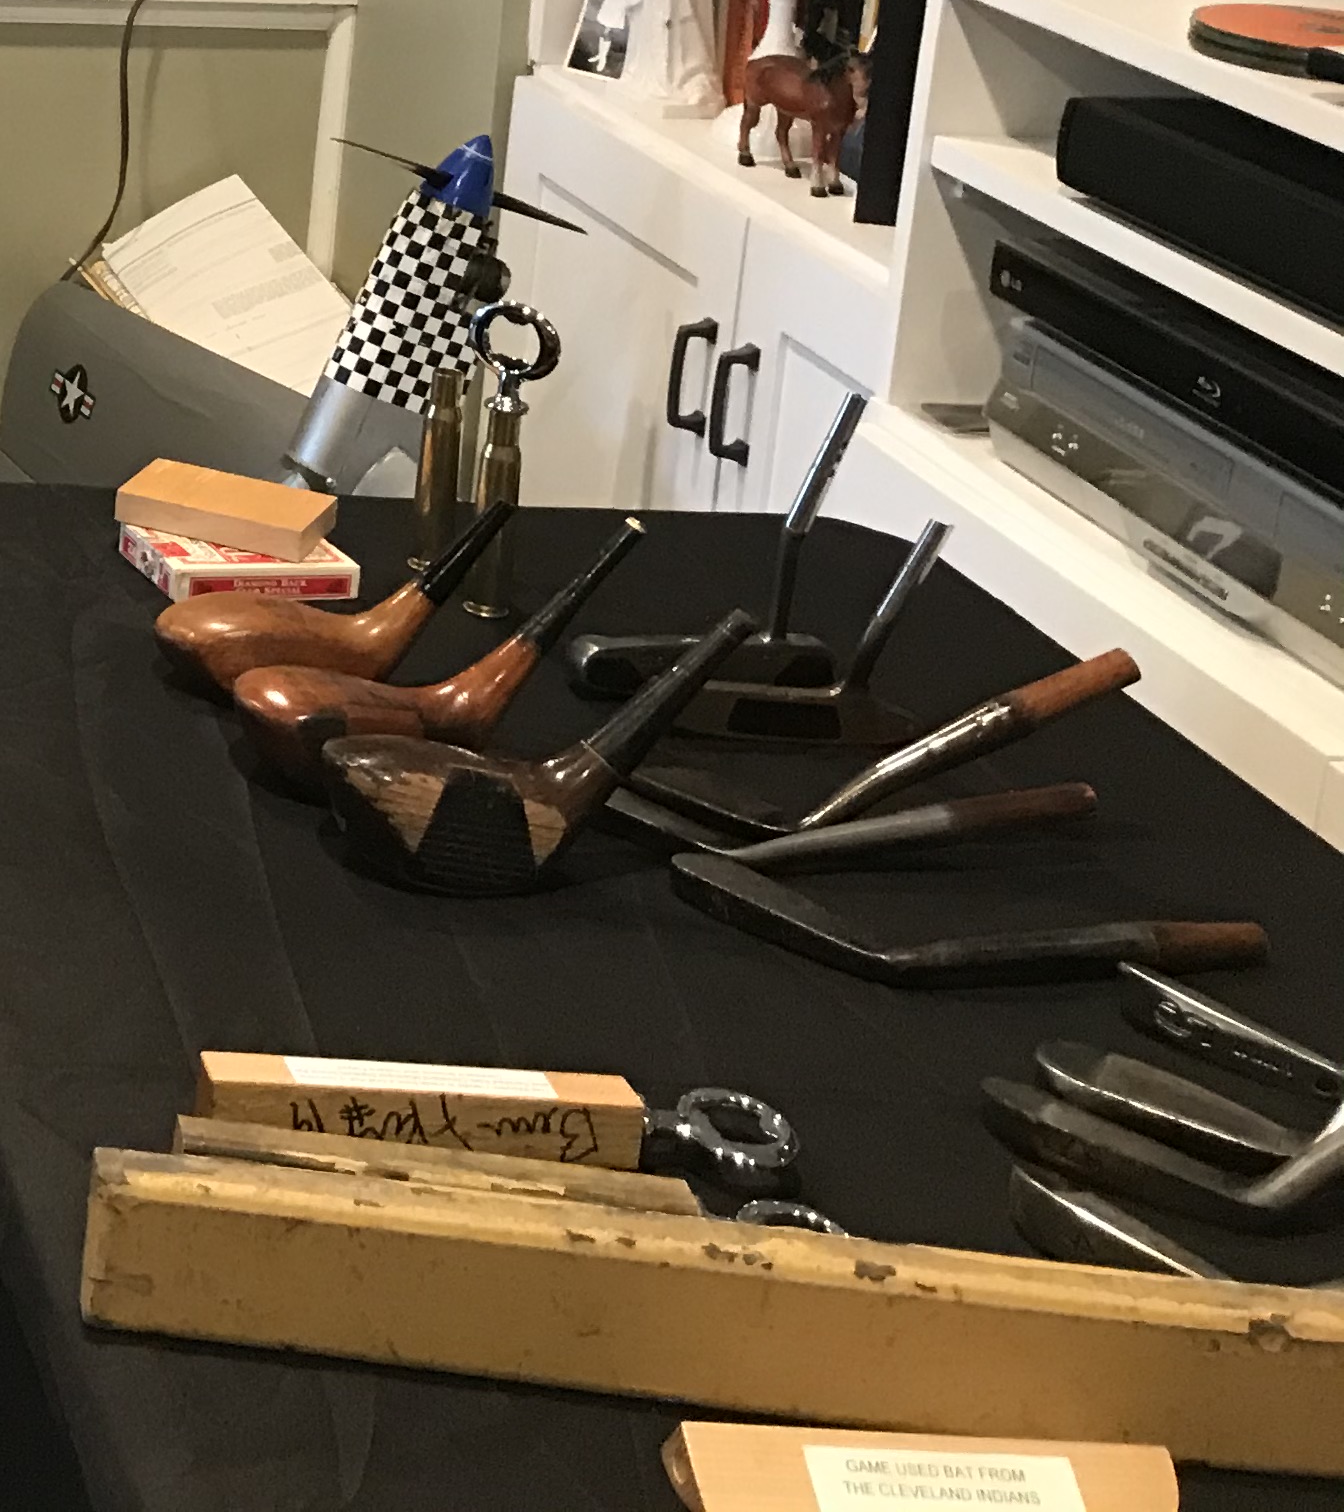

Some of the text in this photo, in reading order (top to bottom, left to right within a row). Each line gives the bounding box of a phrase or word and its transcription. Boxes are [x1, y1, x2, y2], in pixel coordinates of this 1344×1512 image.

[845, 1458, 1027, 1483] GAME USED BAT FROM
[843, 1480, 1041, 1506] THE CLEVELAND INDIANS
